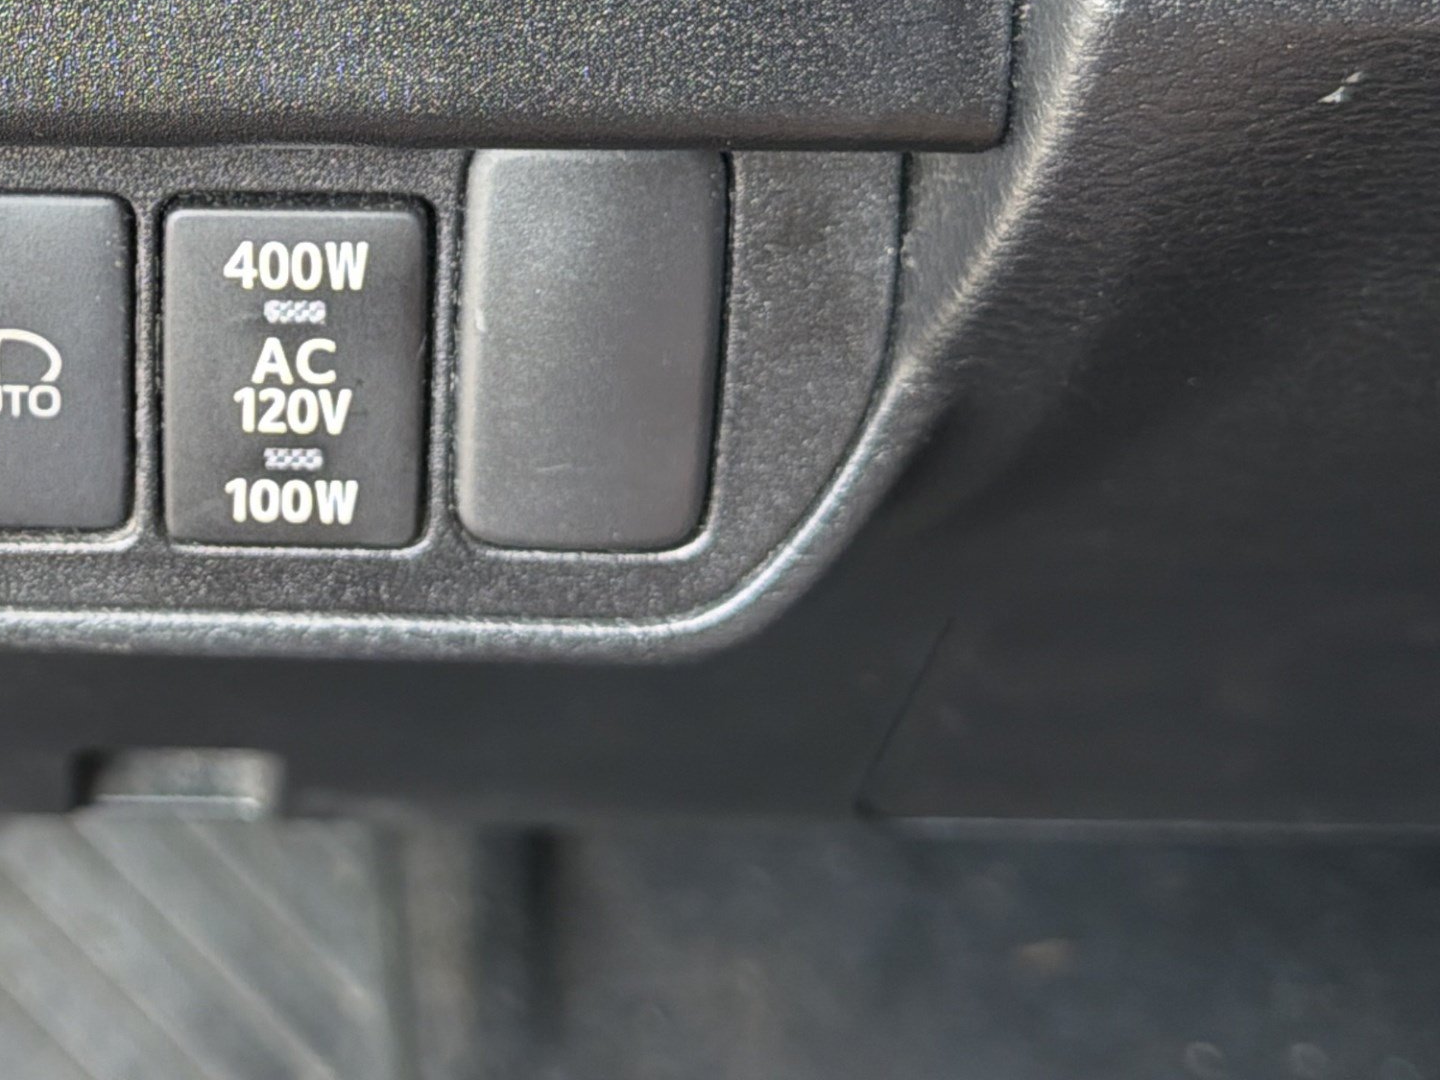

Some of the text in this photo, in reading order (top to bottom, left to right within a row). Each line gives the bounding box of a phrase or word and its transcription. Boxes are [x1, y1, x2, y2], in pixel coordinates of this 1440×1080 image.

[222, 240, 370, 292] 400W
[250, 337, 338, 386] AC
[233, 386, 353, 436] 120V
[223, 477, 360, 526] 100W
